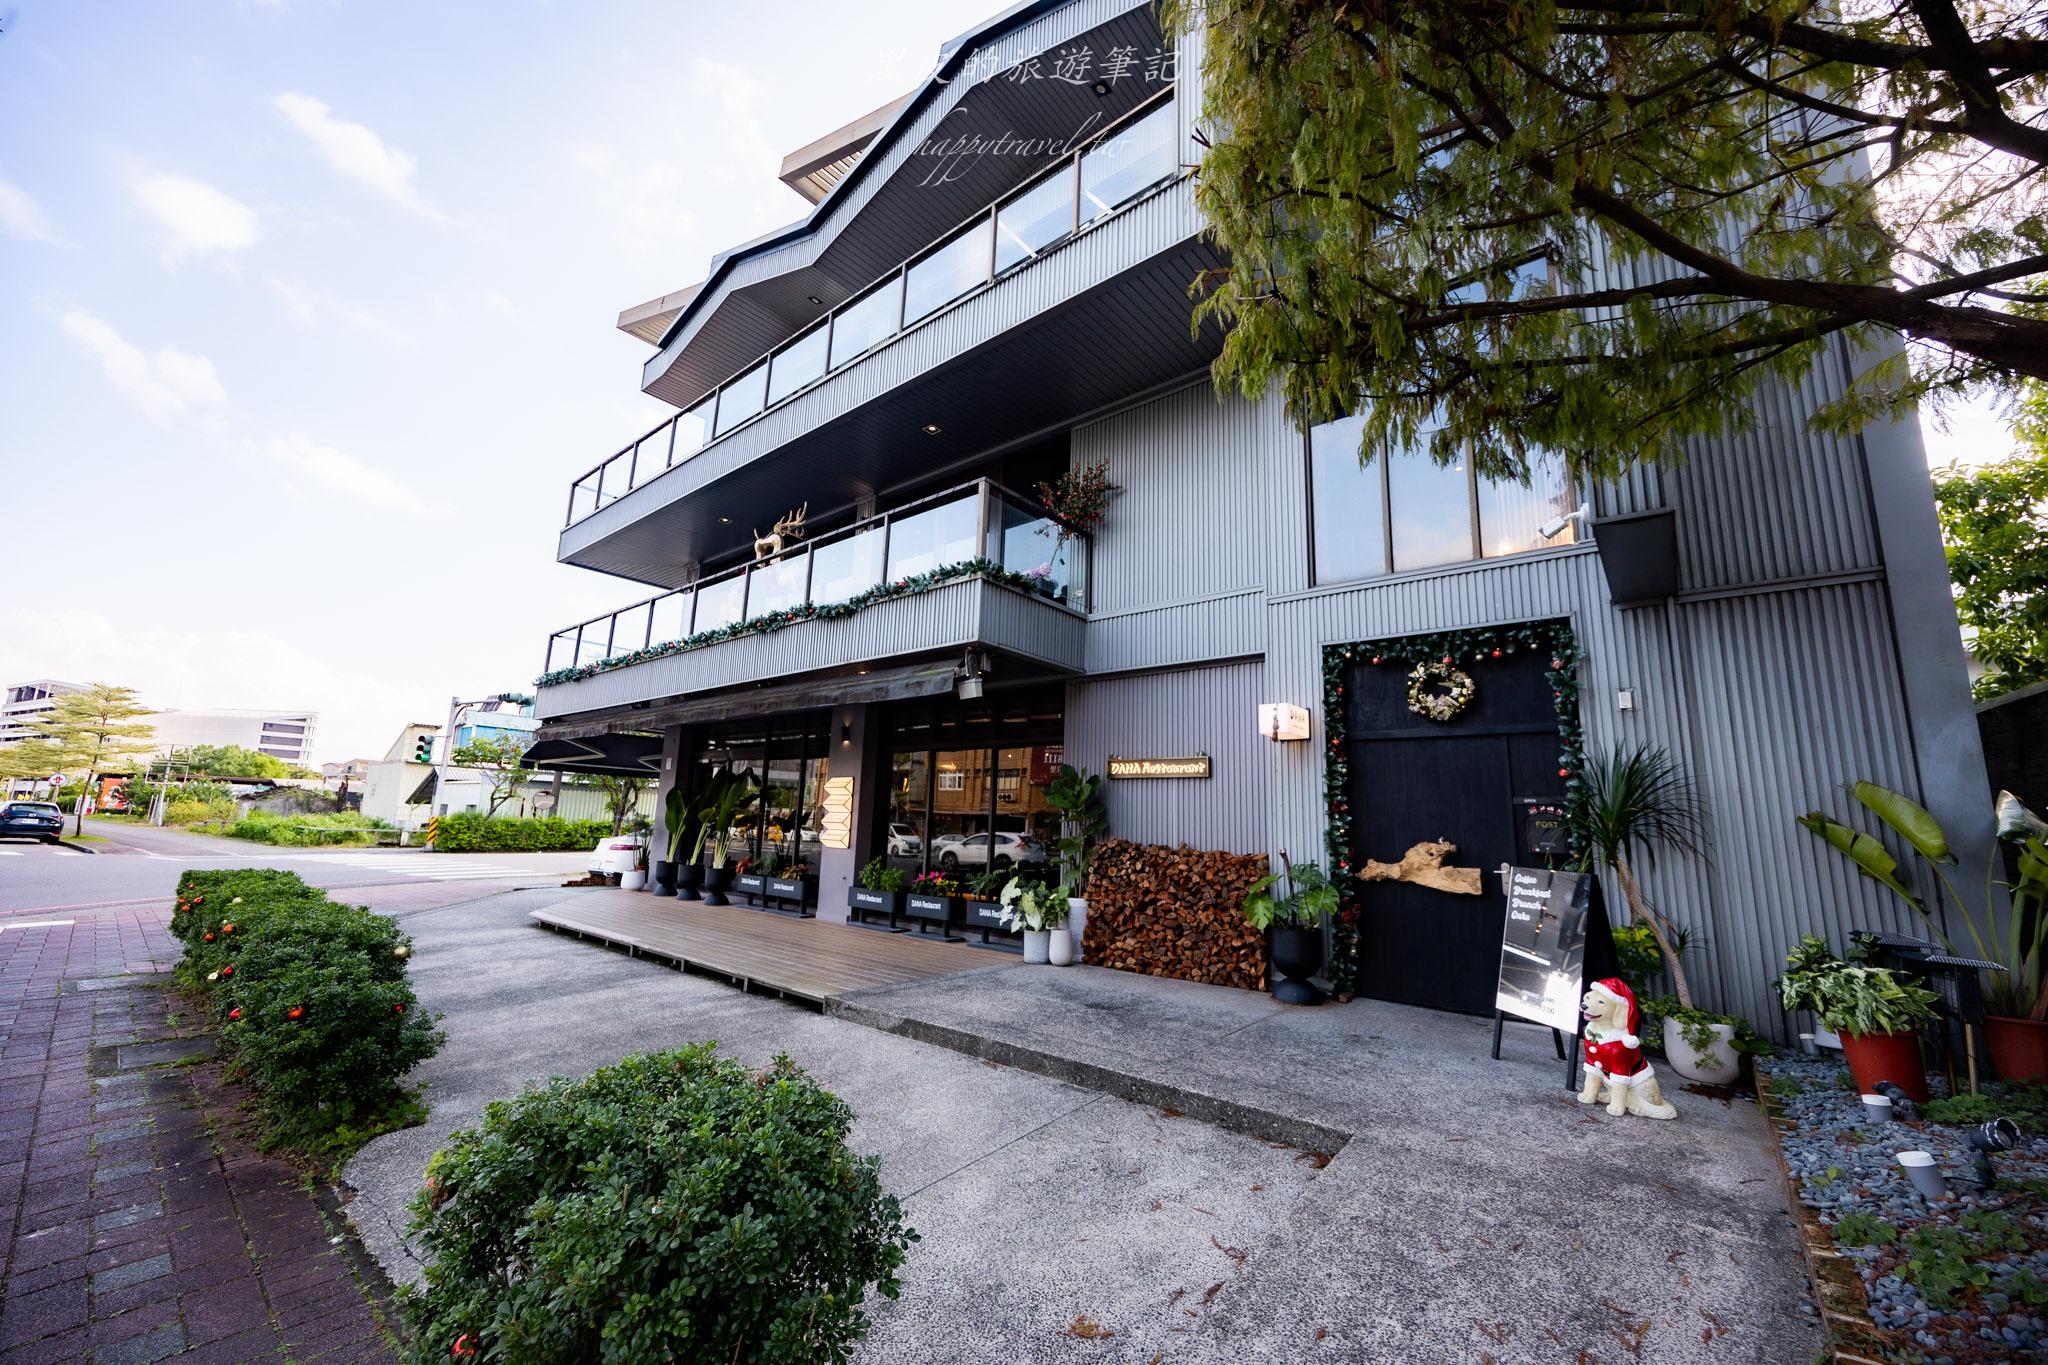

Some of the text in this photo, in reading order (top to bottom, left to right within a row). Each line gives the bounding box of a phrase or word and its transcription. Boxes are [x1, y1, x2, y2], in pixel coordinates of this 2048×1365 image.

[1111, 761, 1206, 774] DANA Restaurant
[1535, 820, 1558, 829] POST
[1514, 873, 1537, 884] Coffee
[1513, 885, 1552, 898] Breakfast
[911, 898, 922, 907] DANA
[1511, 897, 1541, 910] Brunch
[1511, 910, 1531, 921] Cake
